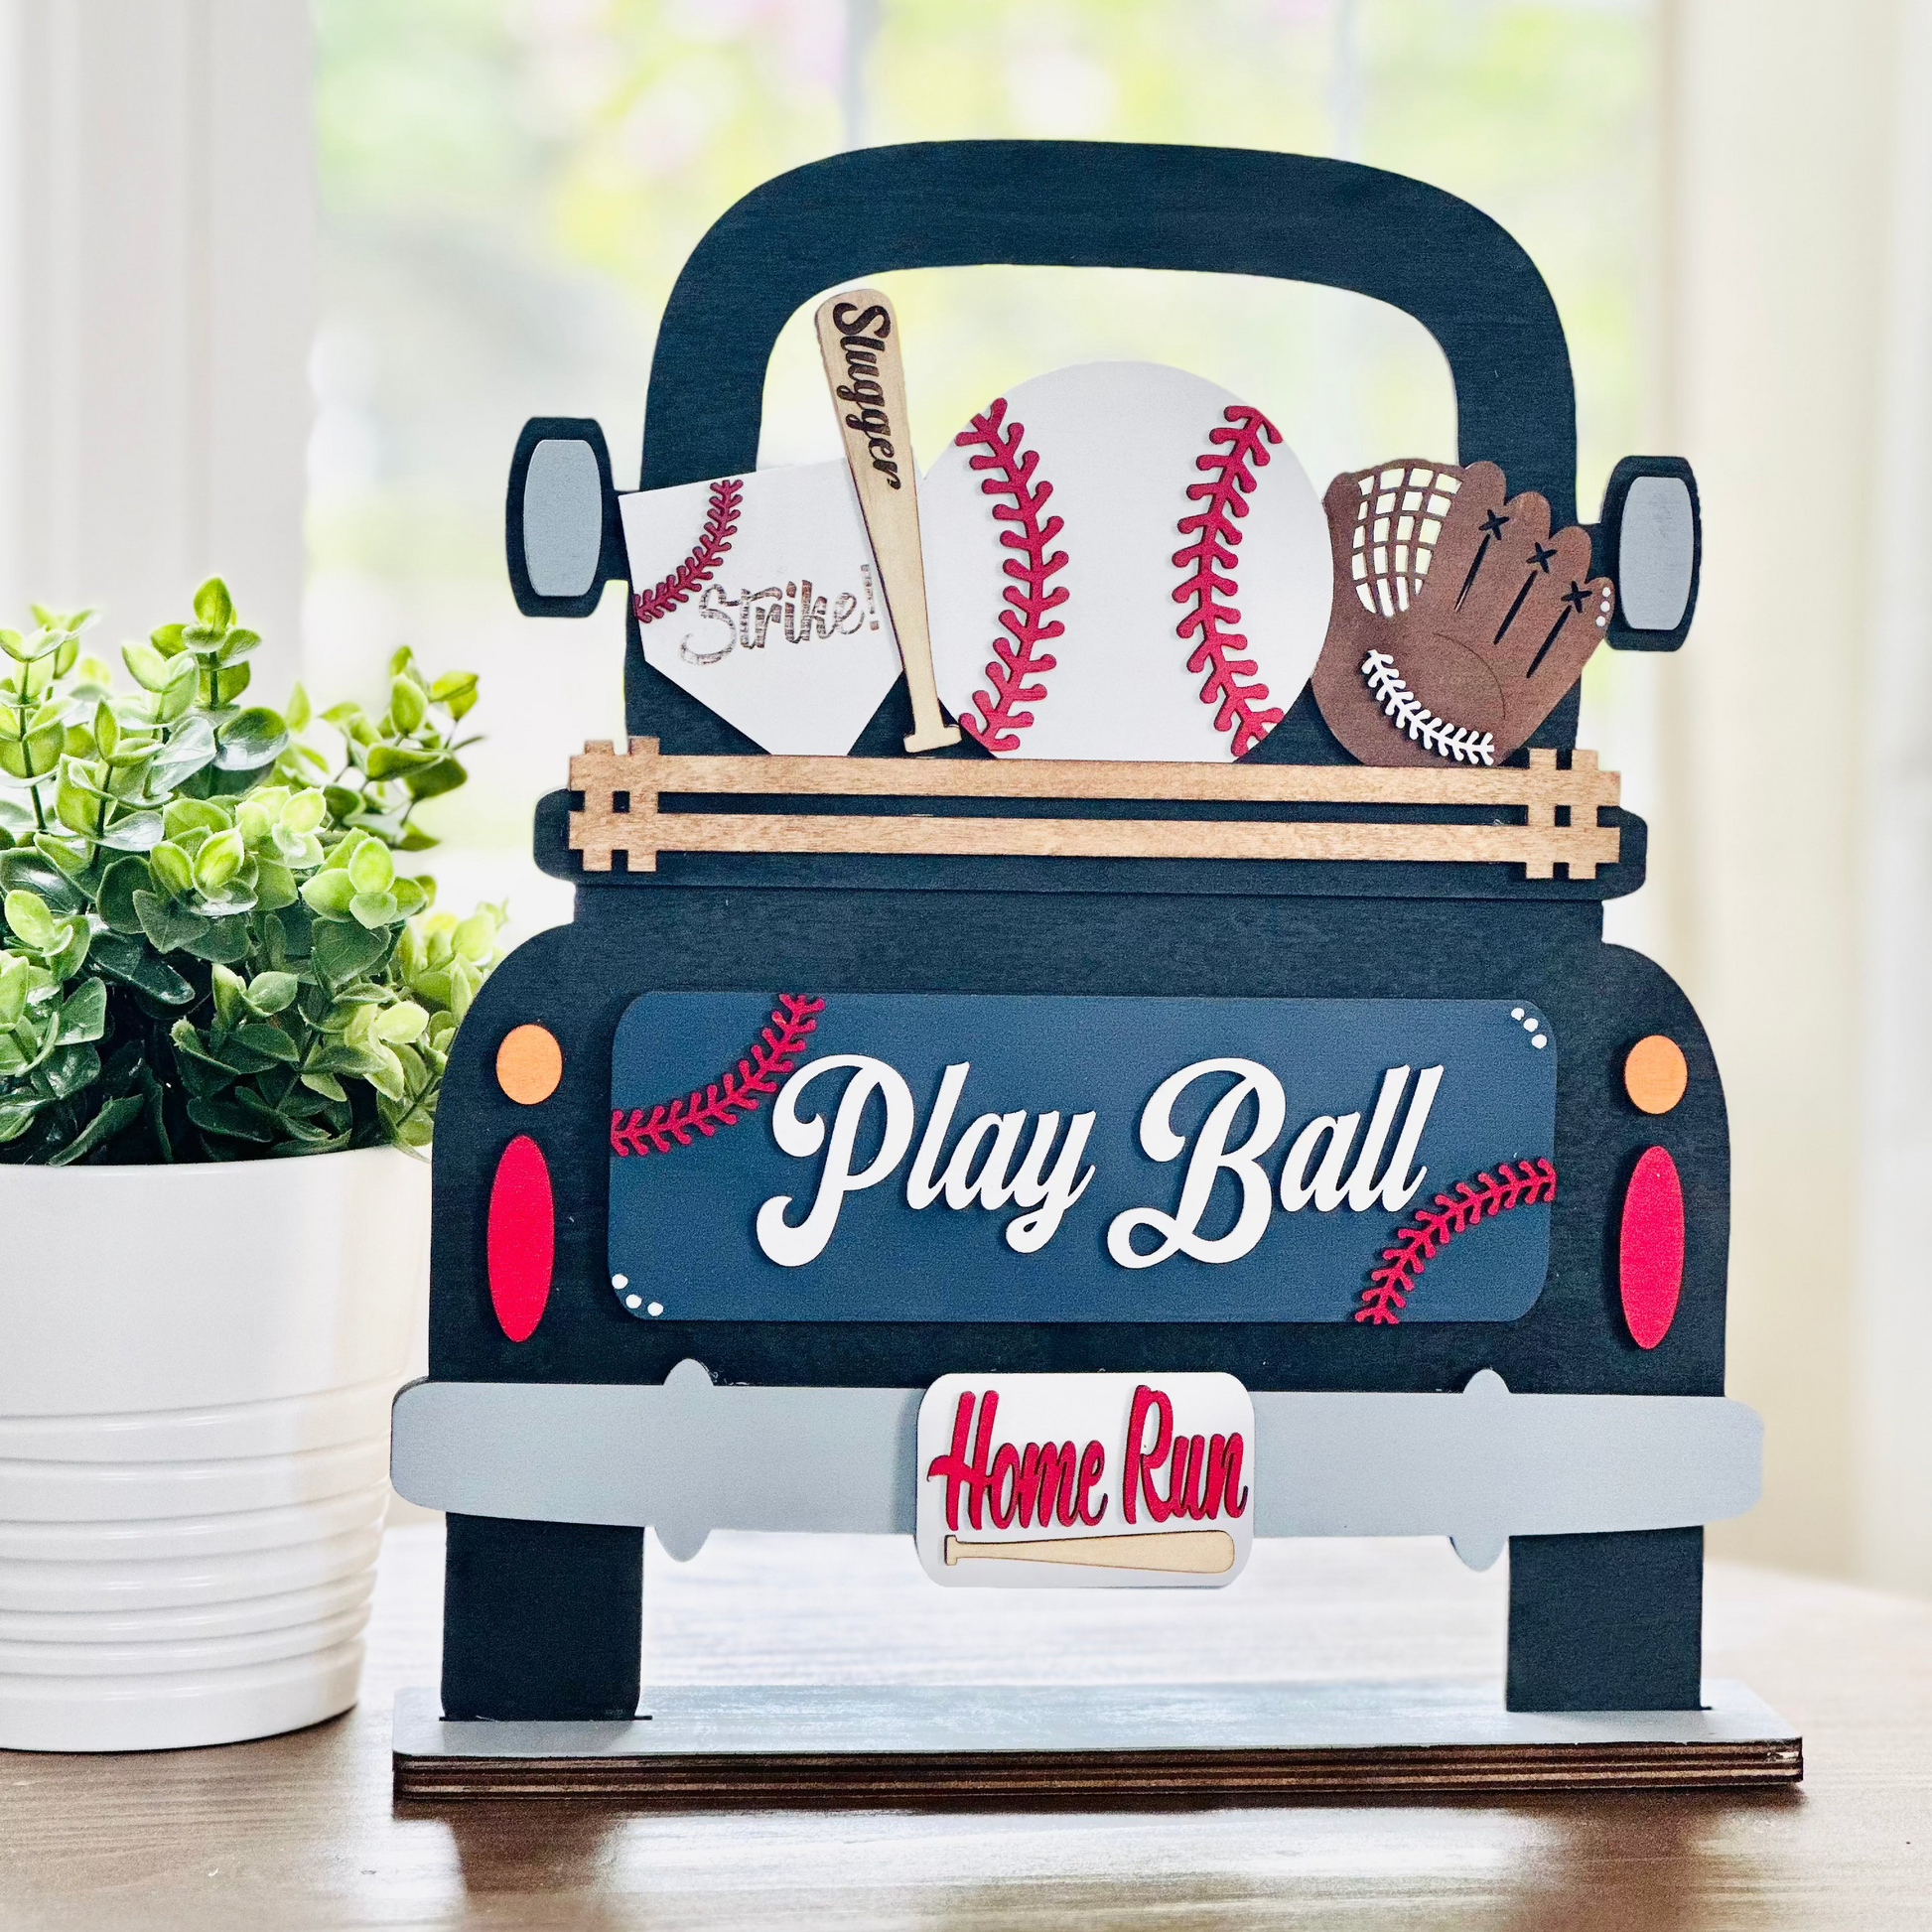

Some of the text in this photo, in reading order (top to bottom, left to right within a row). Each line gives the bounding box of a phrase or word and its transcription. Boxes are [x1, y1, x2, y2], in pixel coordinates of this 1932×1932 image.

[832, 302, 902, 490] Slugger
[679, 564, 881, 666] Strike!
[756, 1053, 1445, 1270] Play Ball
[926, 1384, 1249, 1531] Home Run
